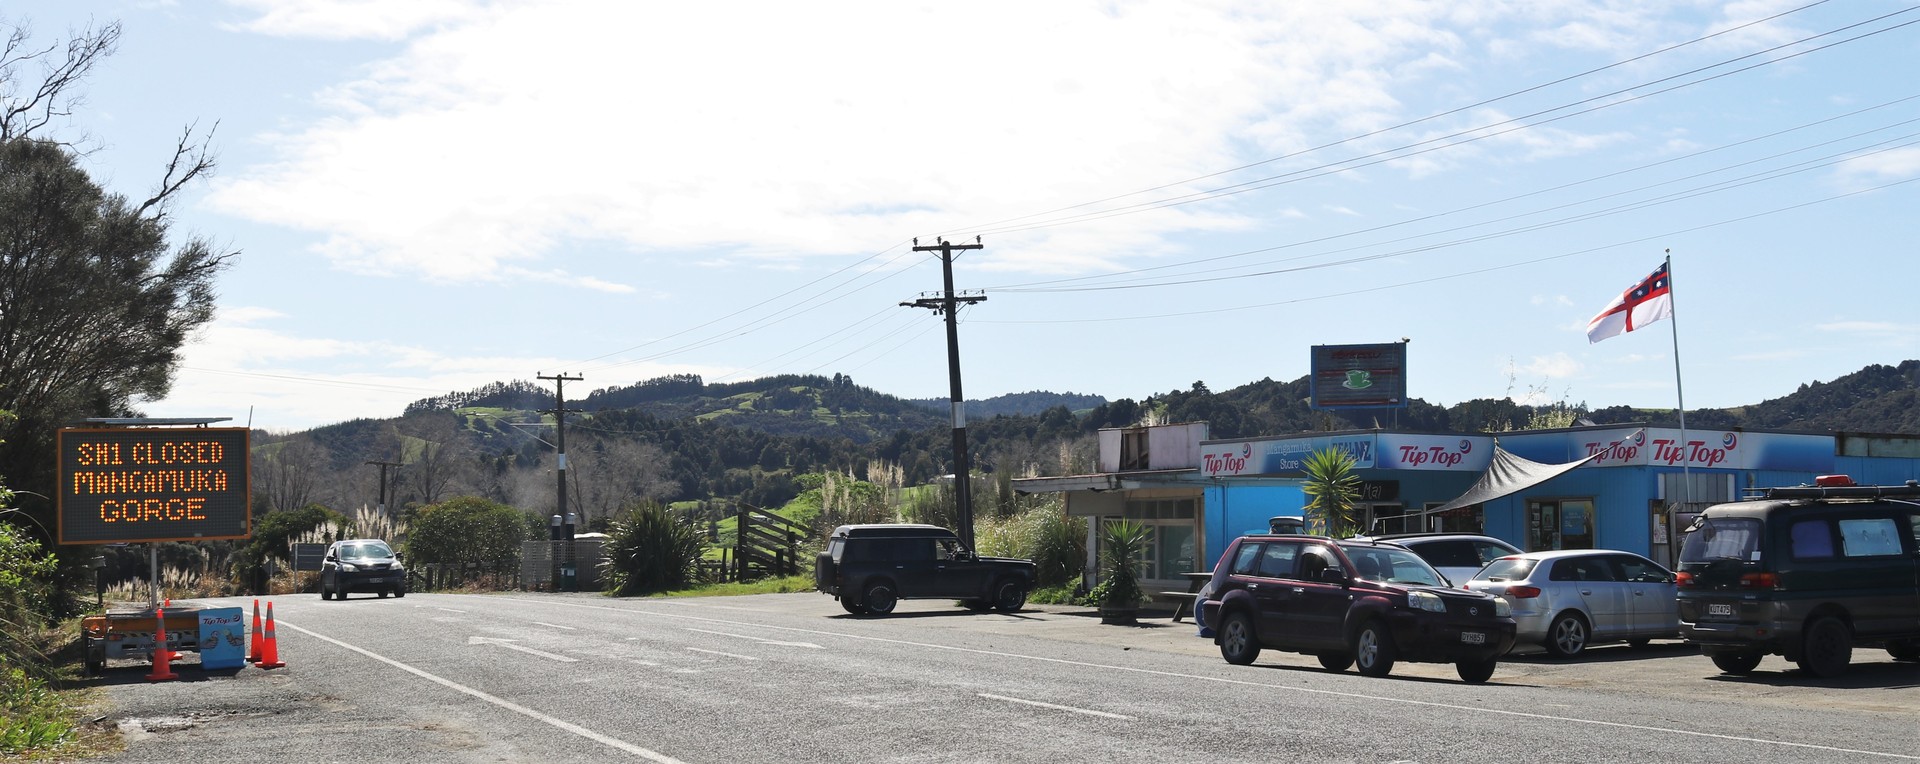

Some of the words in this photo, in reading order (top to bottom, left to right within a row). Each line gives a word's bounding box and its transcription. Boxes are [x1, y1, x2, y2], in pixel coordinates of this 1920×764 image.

[78, 442, 123, 466] SH1
[133, 441, 223, 465] CLOSED
[1203, 453, 1222, 475] Tip
[1222, 452, 1247, 475] Top
[1399, 445, 1428, 467] Tip
[1429, 446, 1462, 468] Top
[1609, 440, 1638, 463] Top
[1651, 439, 1685, 466] Tip
[1687, 440, 1726, 467] Top
[1279, 458, 1299, 470] Store
[74, 469, 227, 495] MANGAMUKA
[100, 497, 206, 523] GORGE
